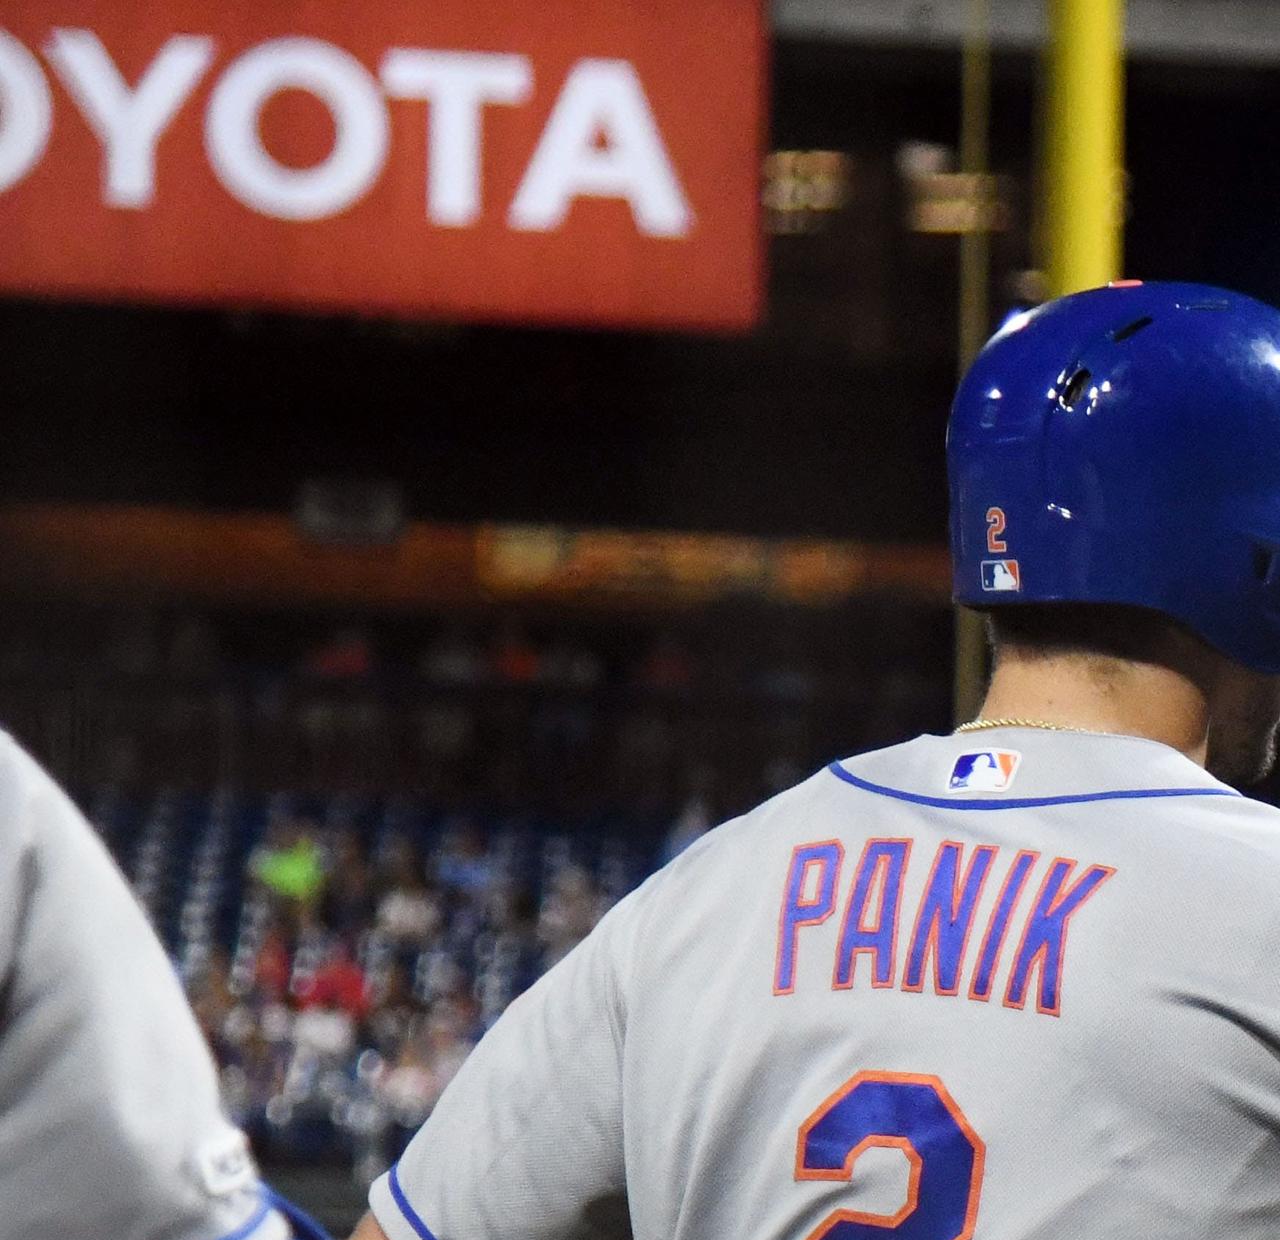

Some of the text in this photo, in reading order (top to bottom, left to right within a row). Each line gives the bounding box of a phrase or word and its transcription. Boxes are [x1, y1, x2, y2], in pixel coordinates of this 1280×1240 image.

[0, 27, 697, 239] YOTA
[986, 506, 1007, 553] 2
[772, 838, 1117, 1017] PANIK
